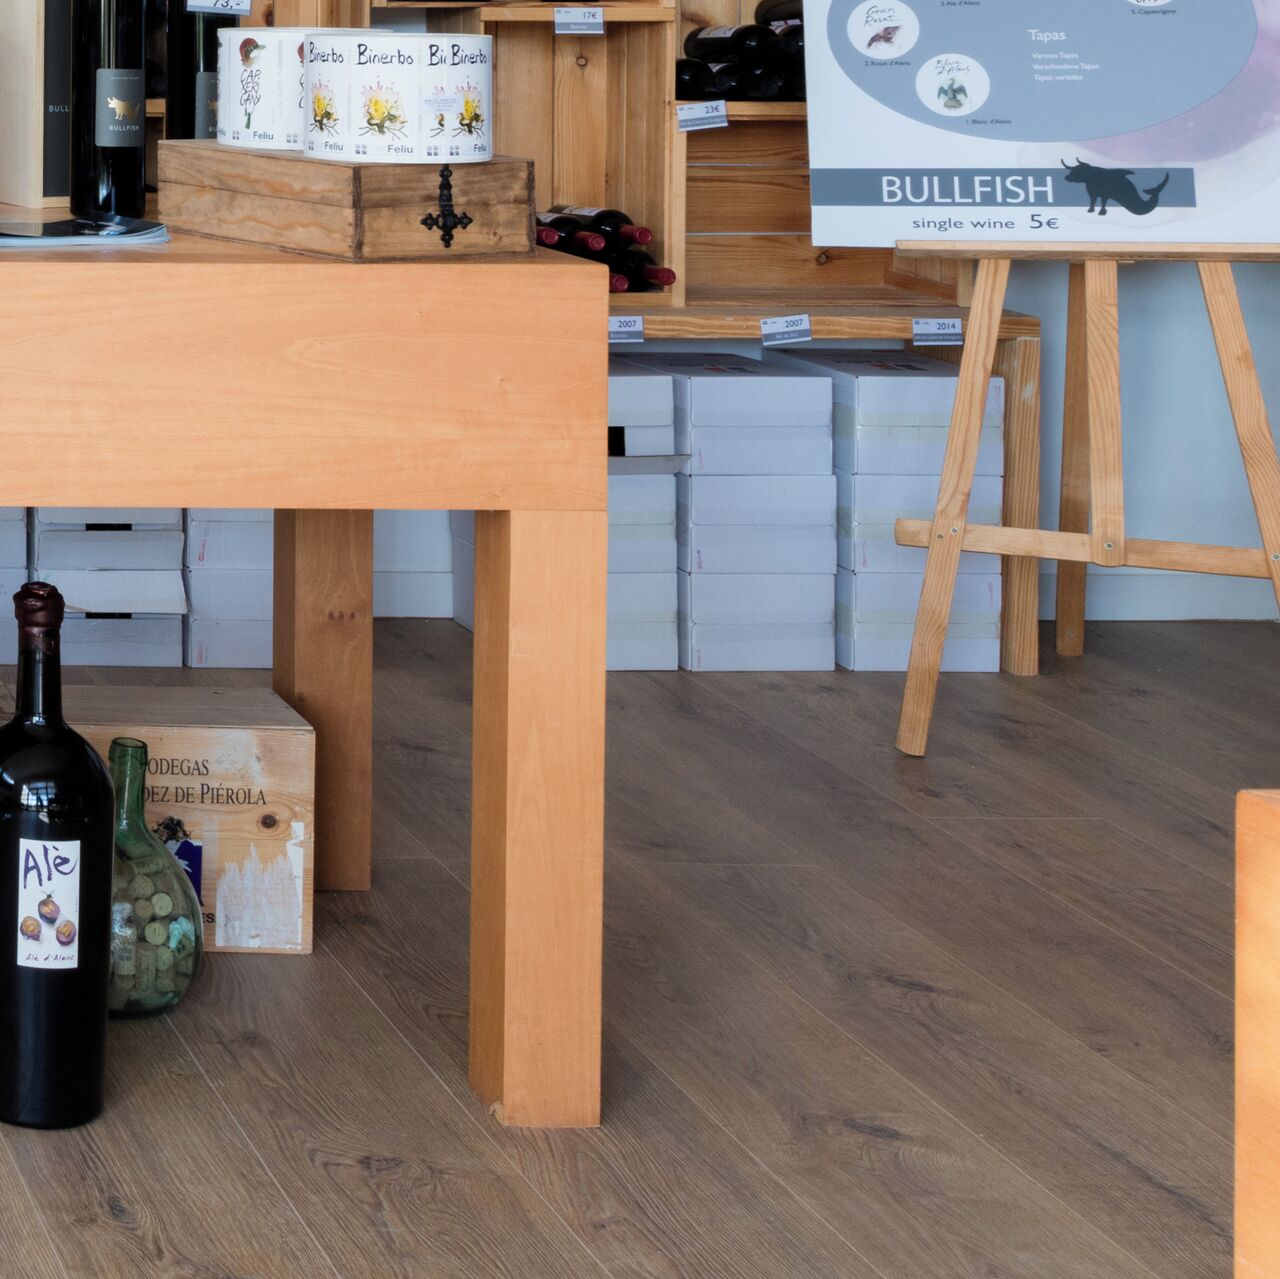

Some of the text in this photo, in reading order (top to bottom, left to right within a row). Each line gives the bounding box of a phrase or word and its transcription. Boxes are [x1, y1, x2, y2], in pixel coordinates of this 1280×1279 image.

[583, 11, 598, 20] 17€
[1027, 29, 1067, 44] Tapas
[309, 42, 345, 64] Binerbo
[356, 42, 415, 66] Binerbo
[450, 43, 488, 66] Binerbo
[704, 104, 721, 114] 23€
[252, 130, 274, 141] Feliu
[324, 140, 344, 151] Feliu
[387, 143, 414, 155] Feliu
[881, 175, 1055, 204] BULLFISH
[913, 213, 1060, 232] single wine 5€
[618, 320, 637, 329] 2007
[784, 318, 804, 329] 2007
[937, 322, 957, 331] 2014
[147, 757, 210, 777] ODEGAS
[174, 786, 196, 804] DE
[199, 781, 267, 806] PIÉROLA
[23, 844, 79, 890] Alè
